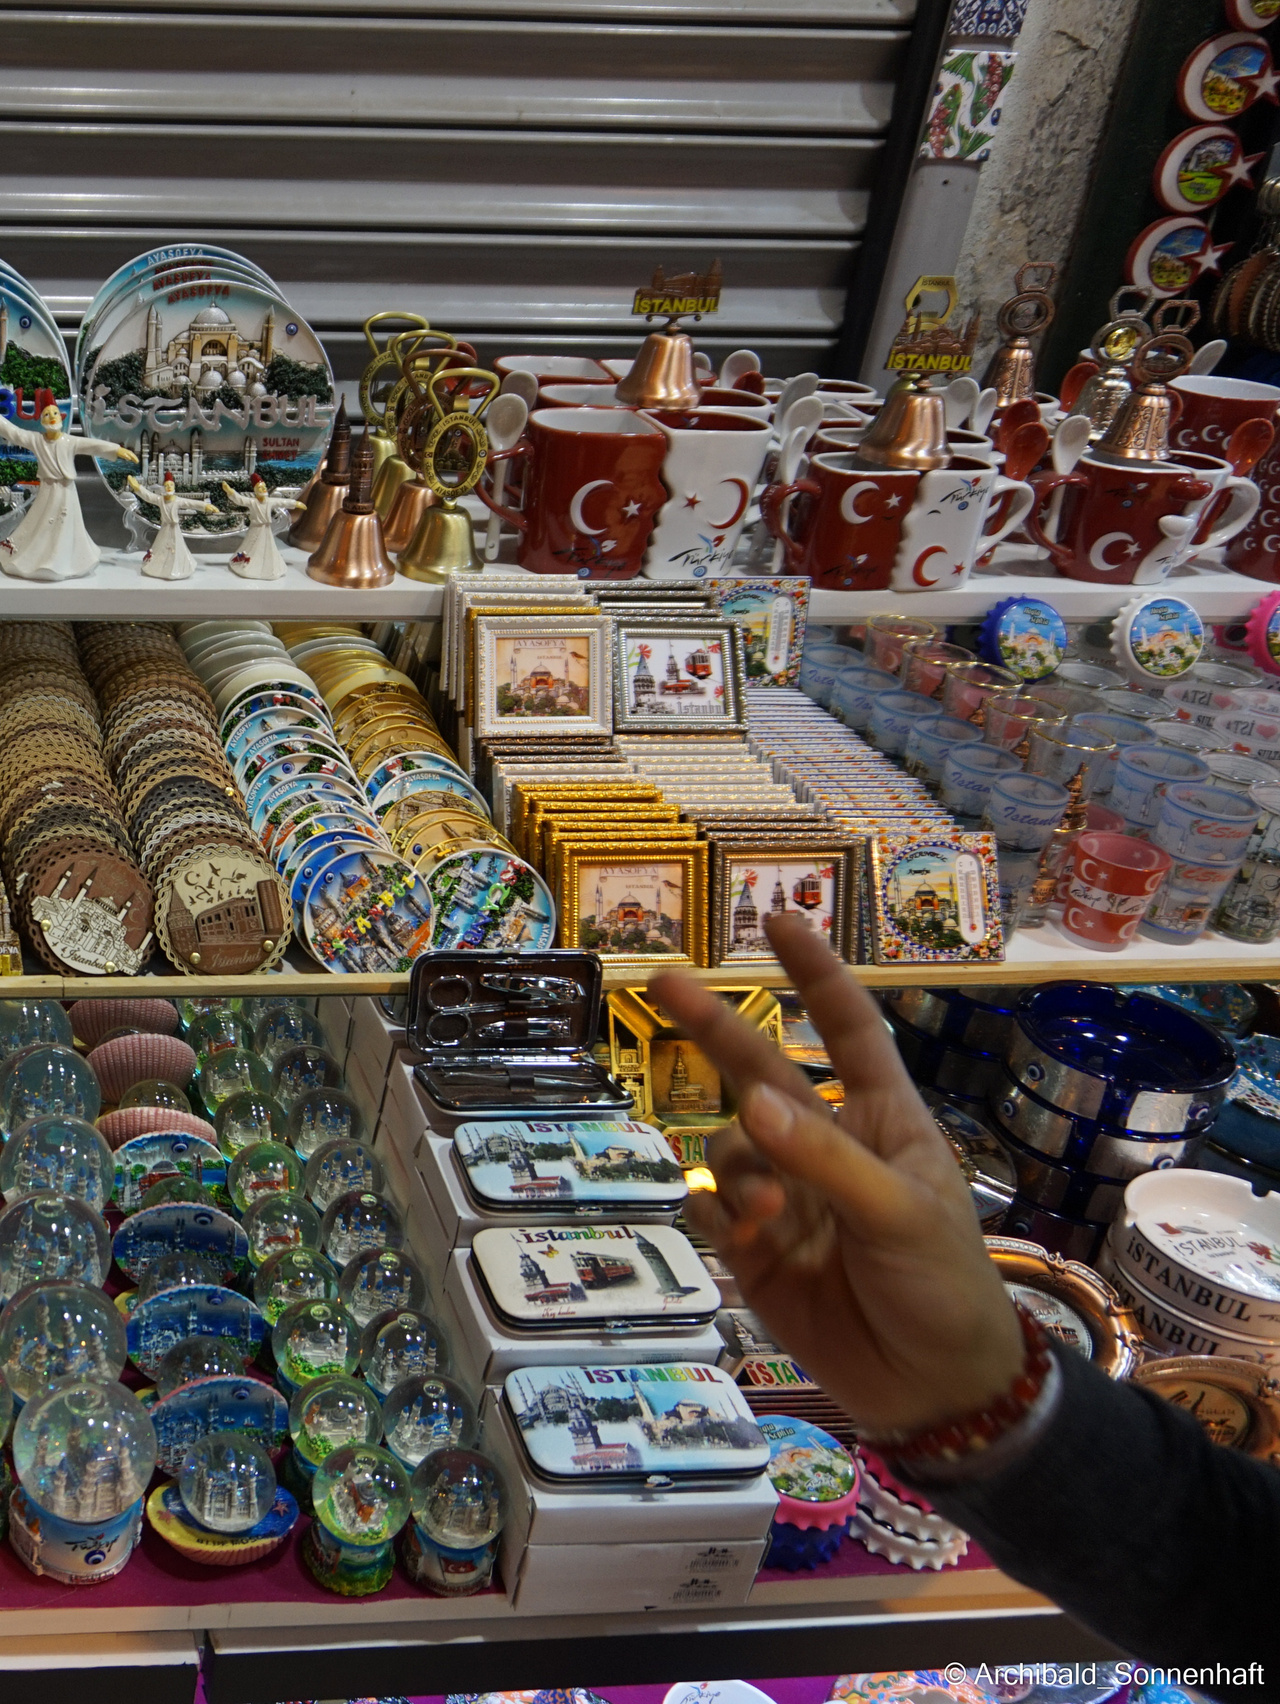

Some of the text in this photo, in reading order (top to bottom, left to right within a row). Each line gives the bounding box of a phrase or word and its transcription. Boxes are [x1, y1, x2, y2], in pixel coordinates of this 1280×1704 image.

[147, 248, 203, 266] AYASOFYA
[167, 284, 230, 305] AYASOFYA
[262, 437, 300, 448] SULTAN
[515, 639, 566, 648] AYASOFYA
[229, 721, 253, 749] AYASOFYA
[248, 733, 279, 756] AYASOFYA
[408, 772, 441, 783] AYASOFYA
[247, 781, 263, 818] AYASOFYA
[267, 780, 299, 804] AYASOFYA
[600, 865, 659, 877] AYASOFYA
